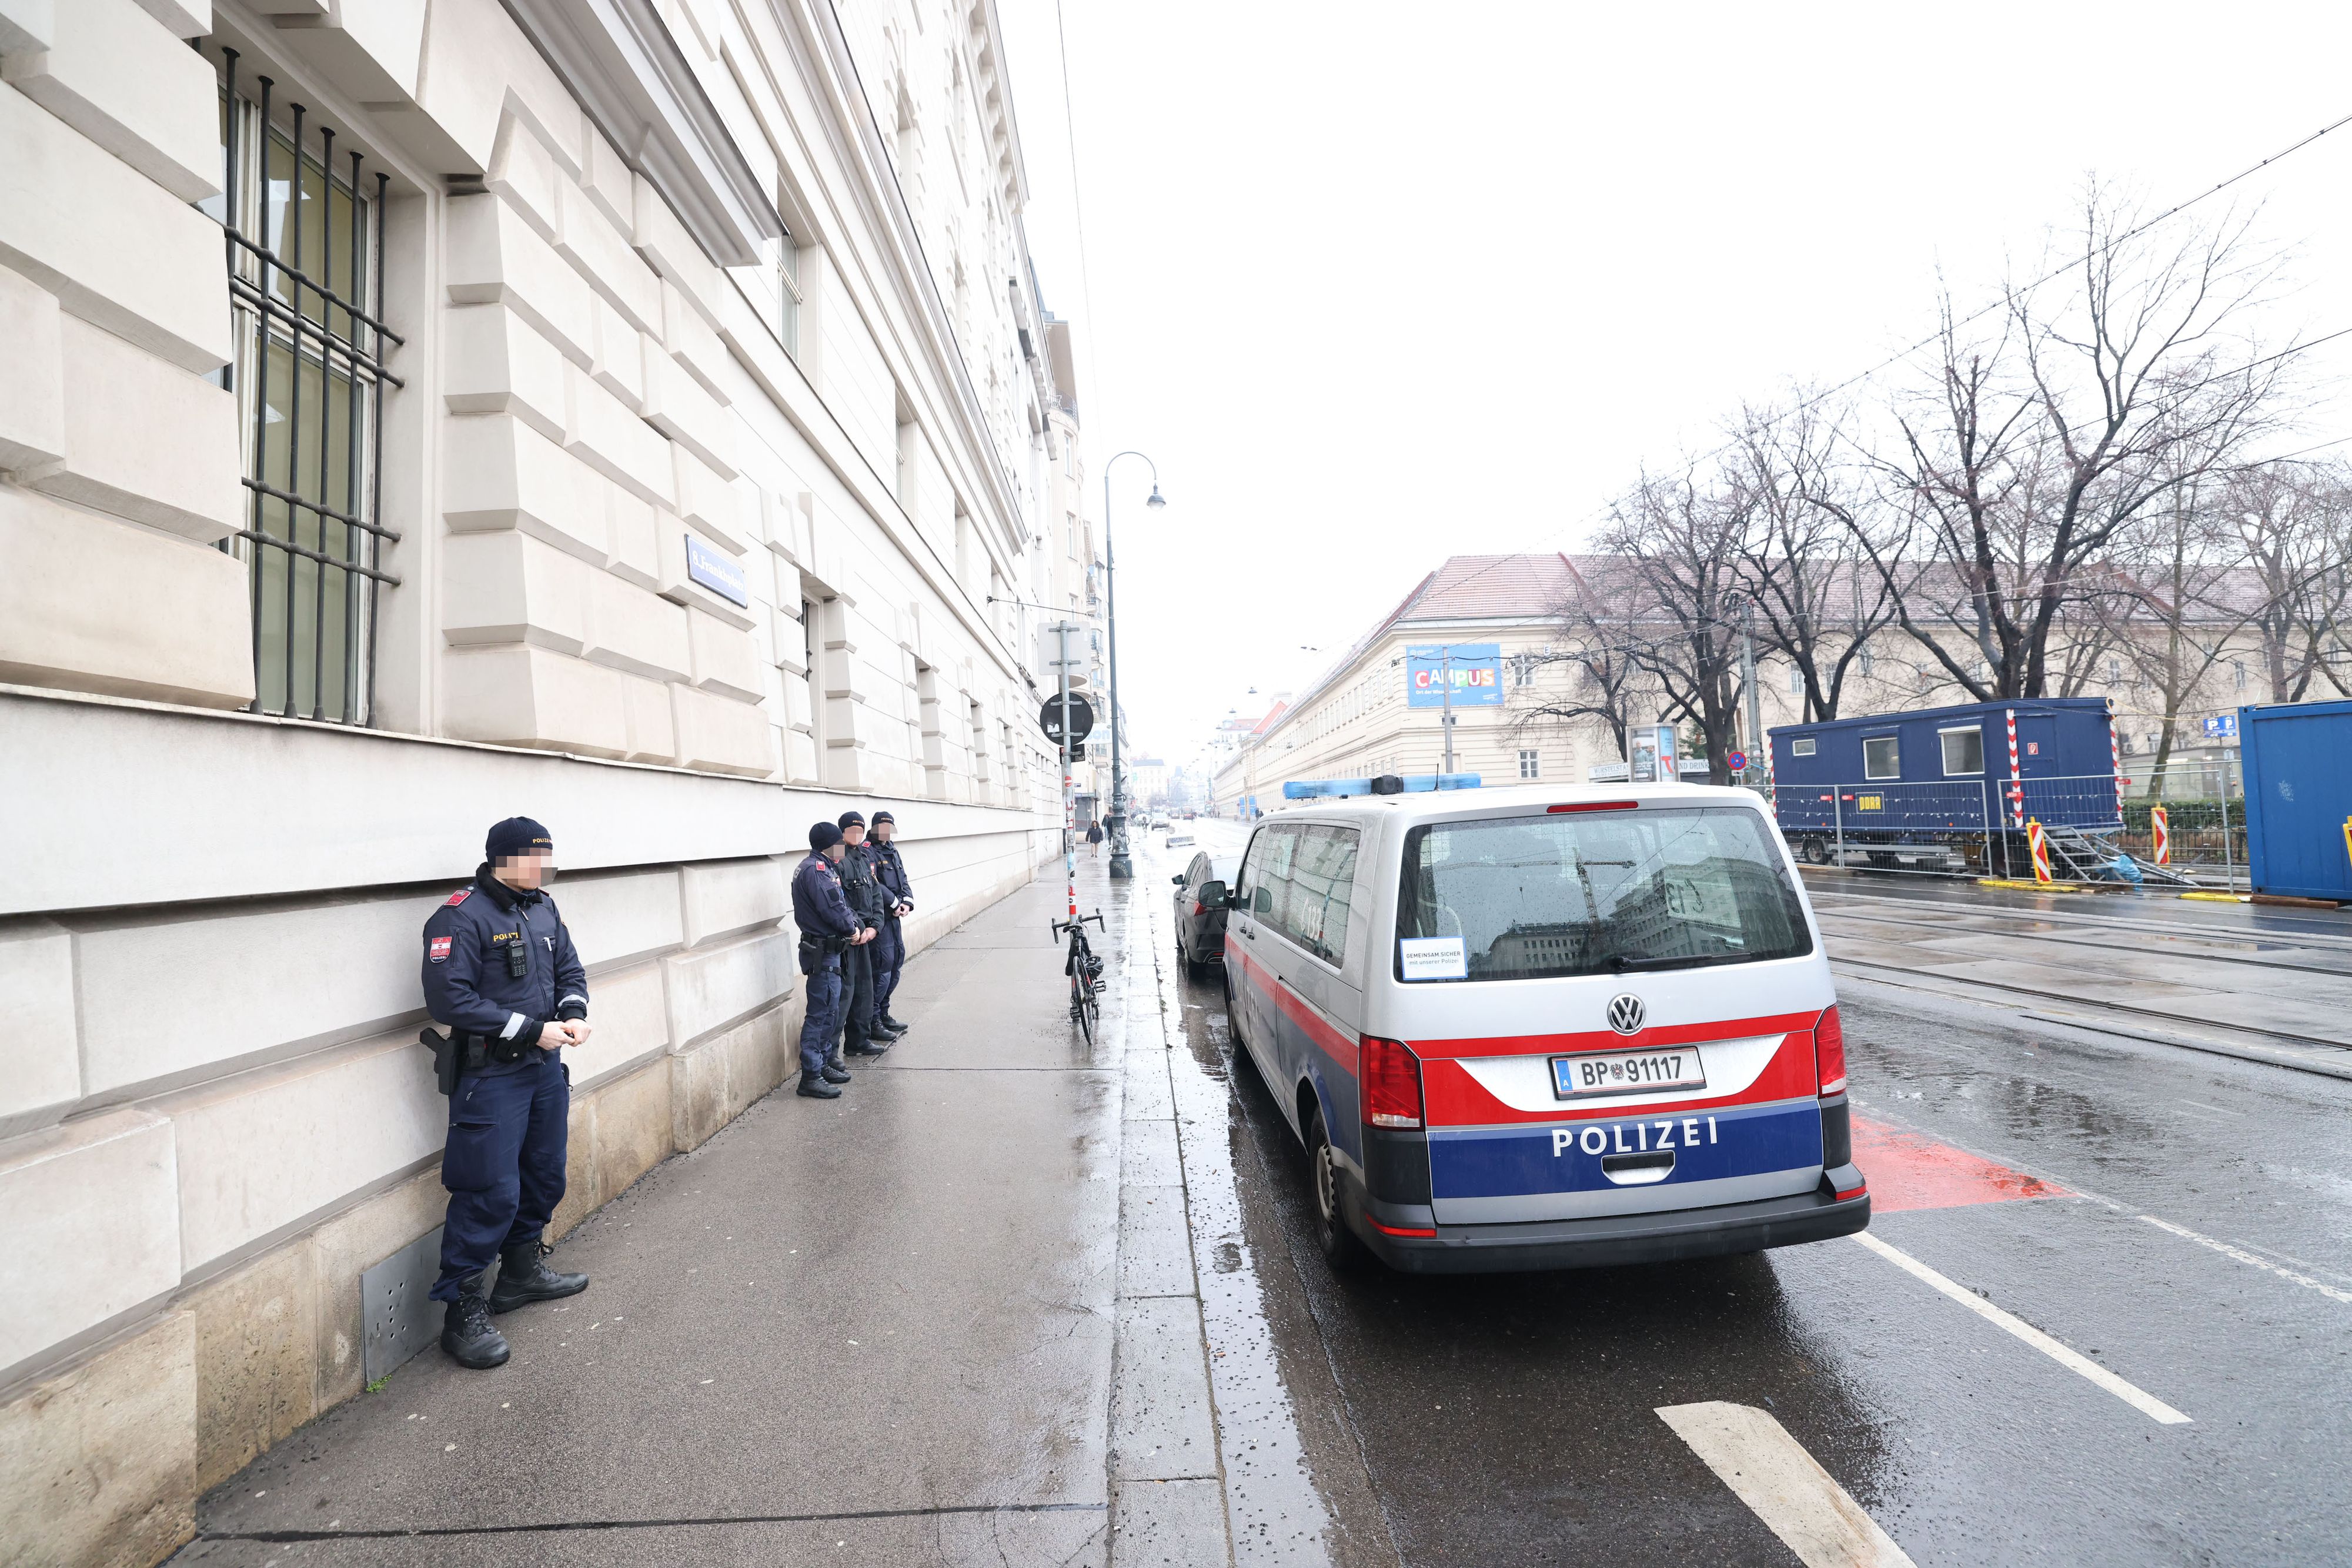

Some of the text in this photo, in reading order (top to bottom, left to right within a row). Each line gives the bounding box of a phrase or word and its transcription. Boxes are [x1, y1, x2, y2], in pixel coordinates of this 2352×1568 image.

[1416, 669, 1493, 687] CAMPUS
[2207, 719, 2233, 730] P P
[1406, 951, 1461, 959] GEMEINSAM.SICHER
[1581, 1062, 1608, 1086] BP
[1626, 1056, 1682, 1082] 91117
[1551, 1116, 1718, 1158] POLIZEI
